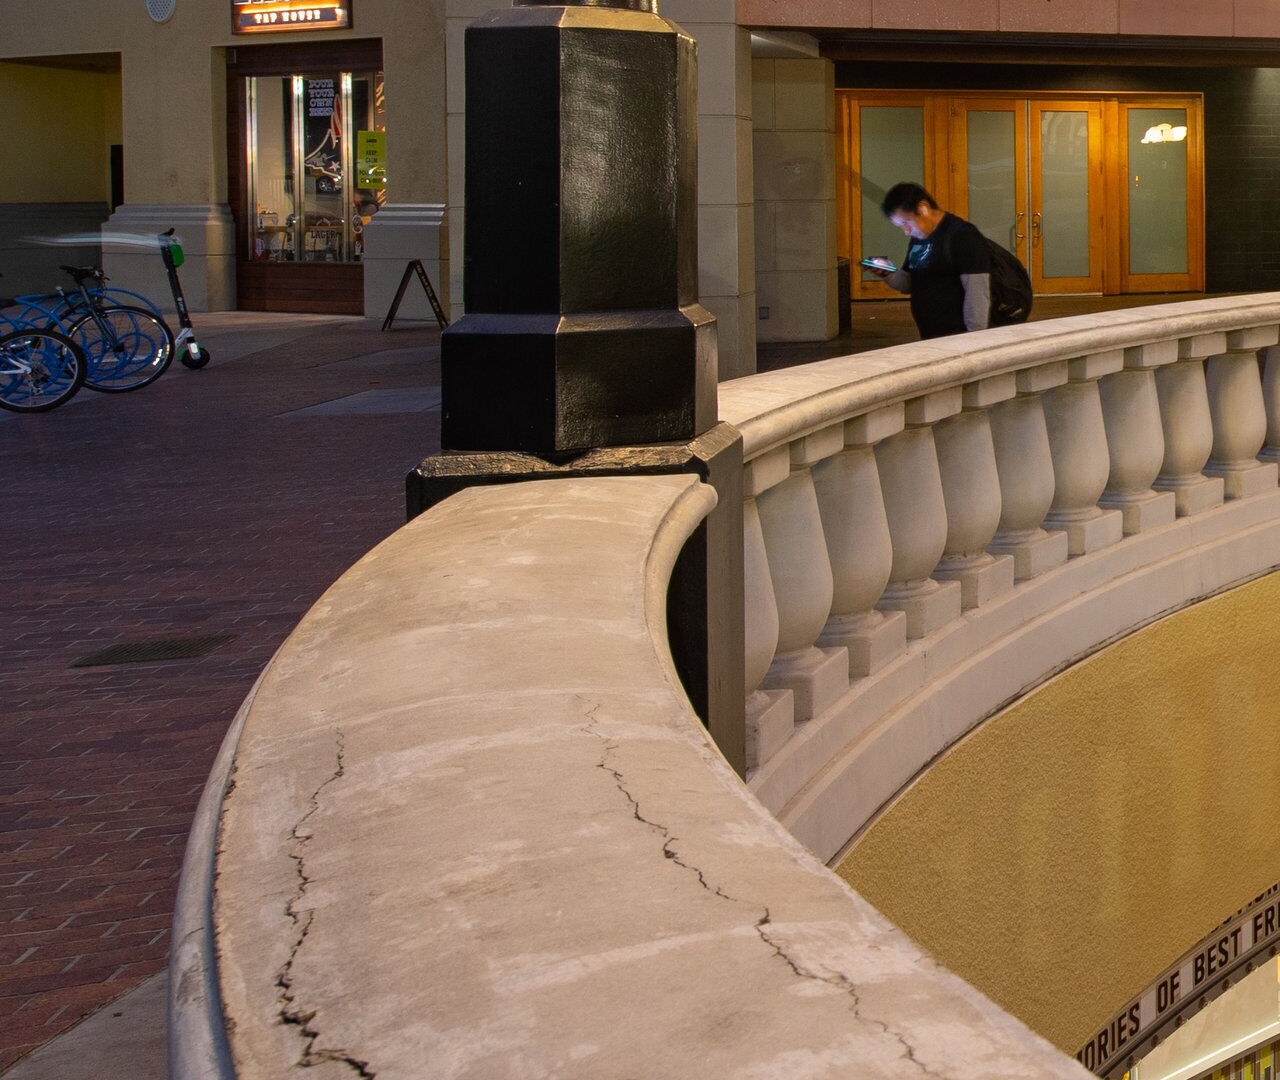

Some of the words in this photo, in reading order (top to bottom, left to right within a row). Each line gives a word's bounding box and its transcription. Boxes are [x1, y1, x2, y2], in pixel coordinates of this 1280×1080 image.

[254, 11, 278, 25] TAP
[281, 9, 321, 23] HOUSE
[308, 88, 335, 98] YOUR
[309, 97, 334, 107] OWN
[1156, 970, 1181, 1015] OF
[1192, 926, 1242, 987] BEST
